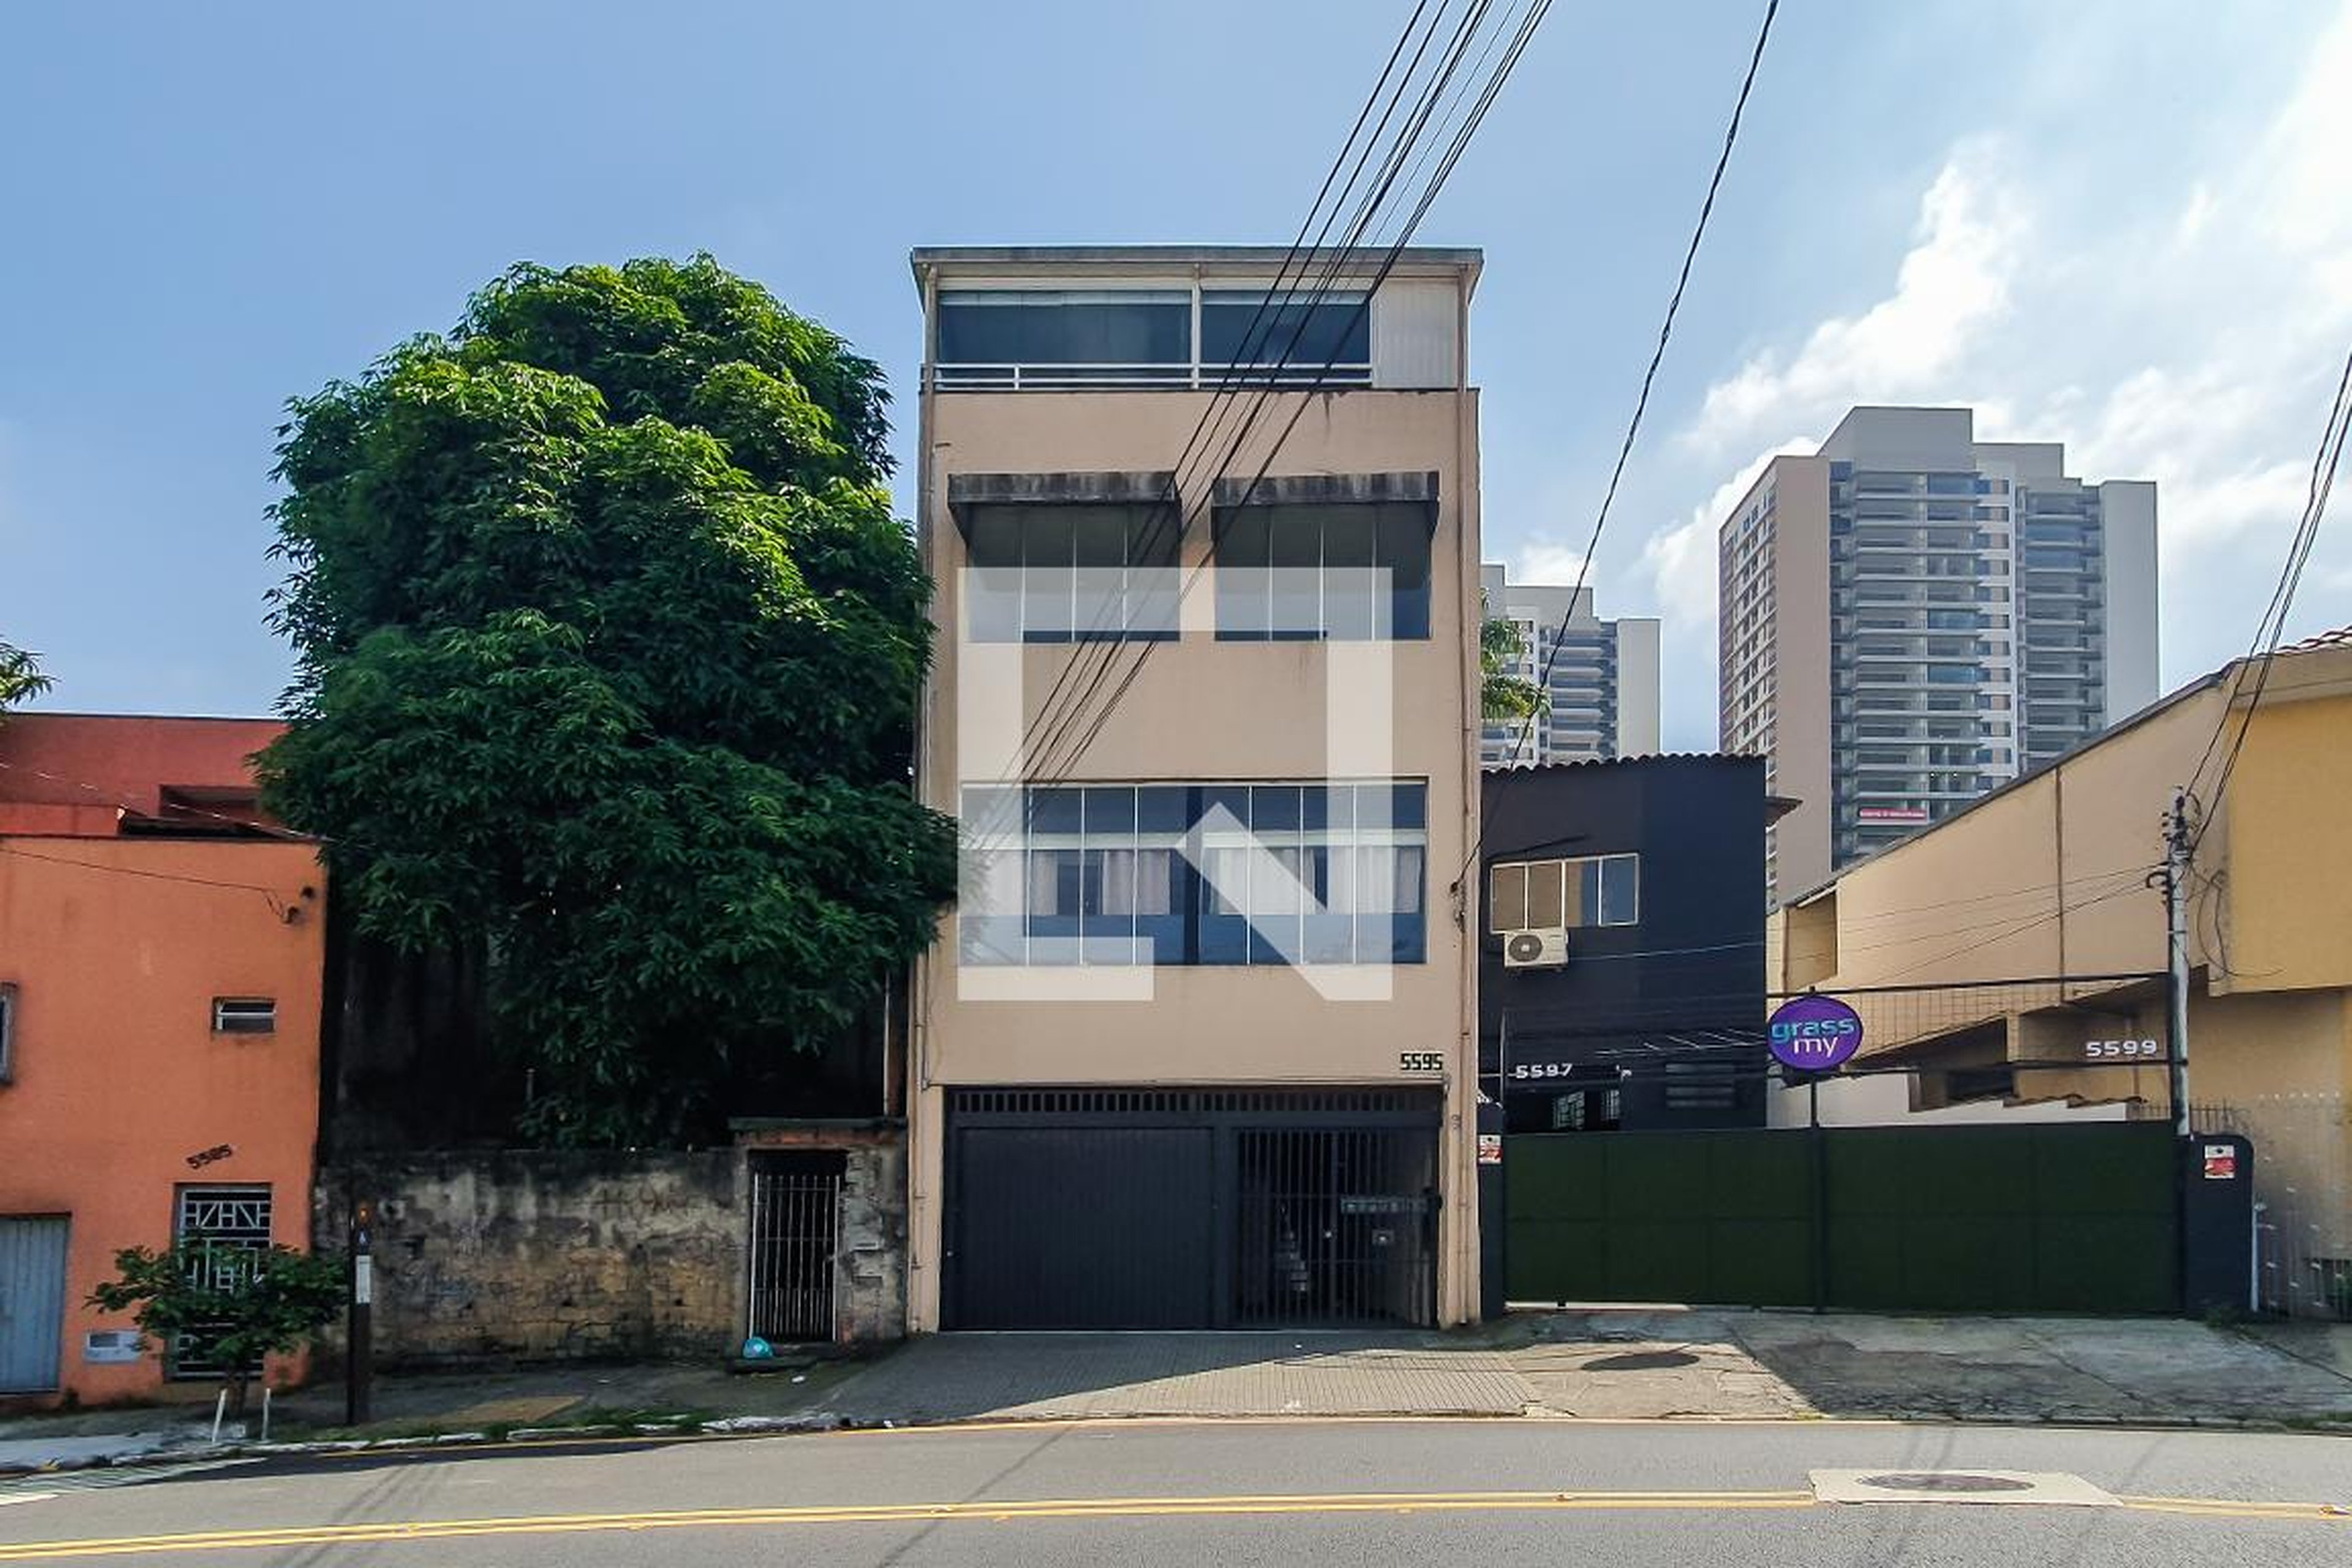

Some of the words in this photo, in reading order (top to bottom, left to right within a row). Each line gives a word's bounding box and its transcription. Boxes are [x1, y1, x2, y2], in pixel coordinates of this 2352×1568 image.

[1771, 1019, 1855, 1044] grass
[1794, 1036, 1838, 1058] my
[2086, 1040, 2157, 1057] 5599
[1400, 1053, 1443, 1070] 5595
[1516, 1063, 1573, 1079] 5597
